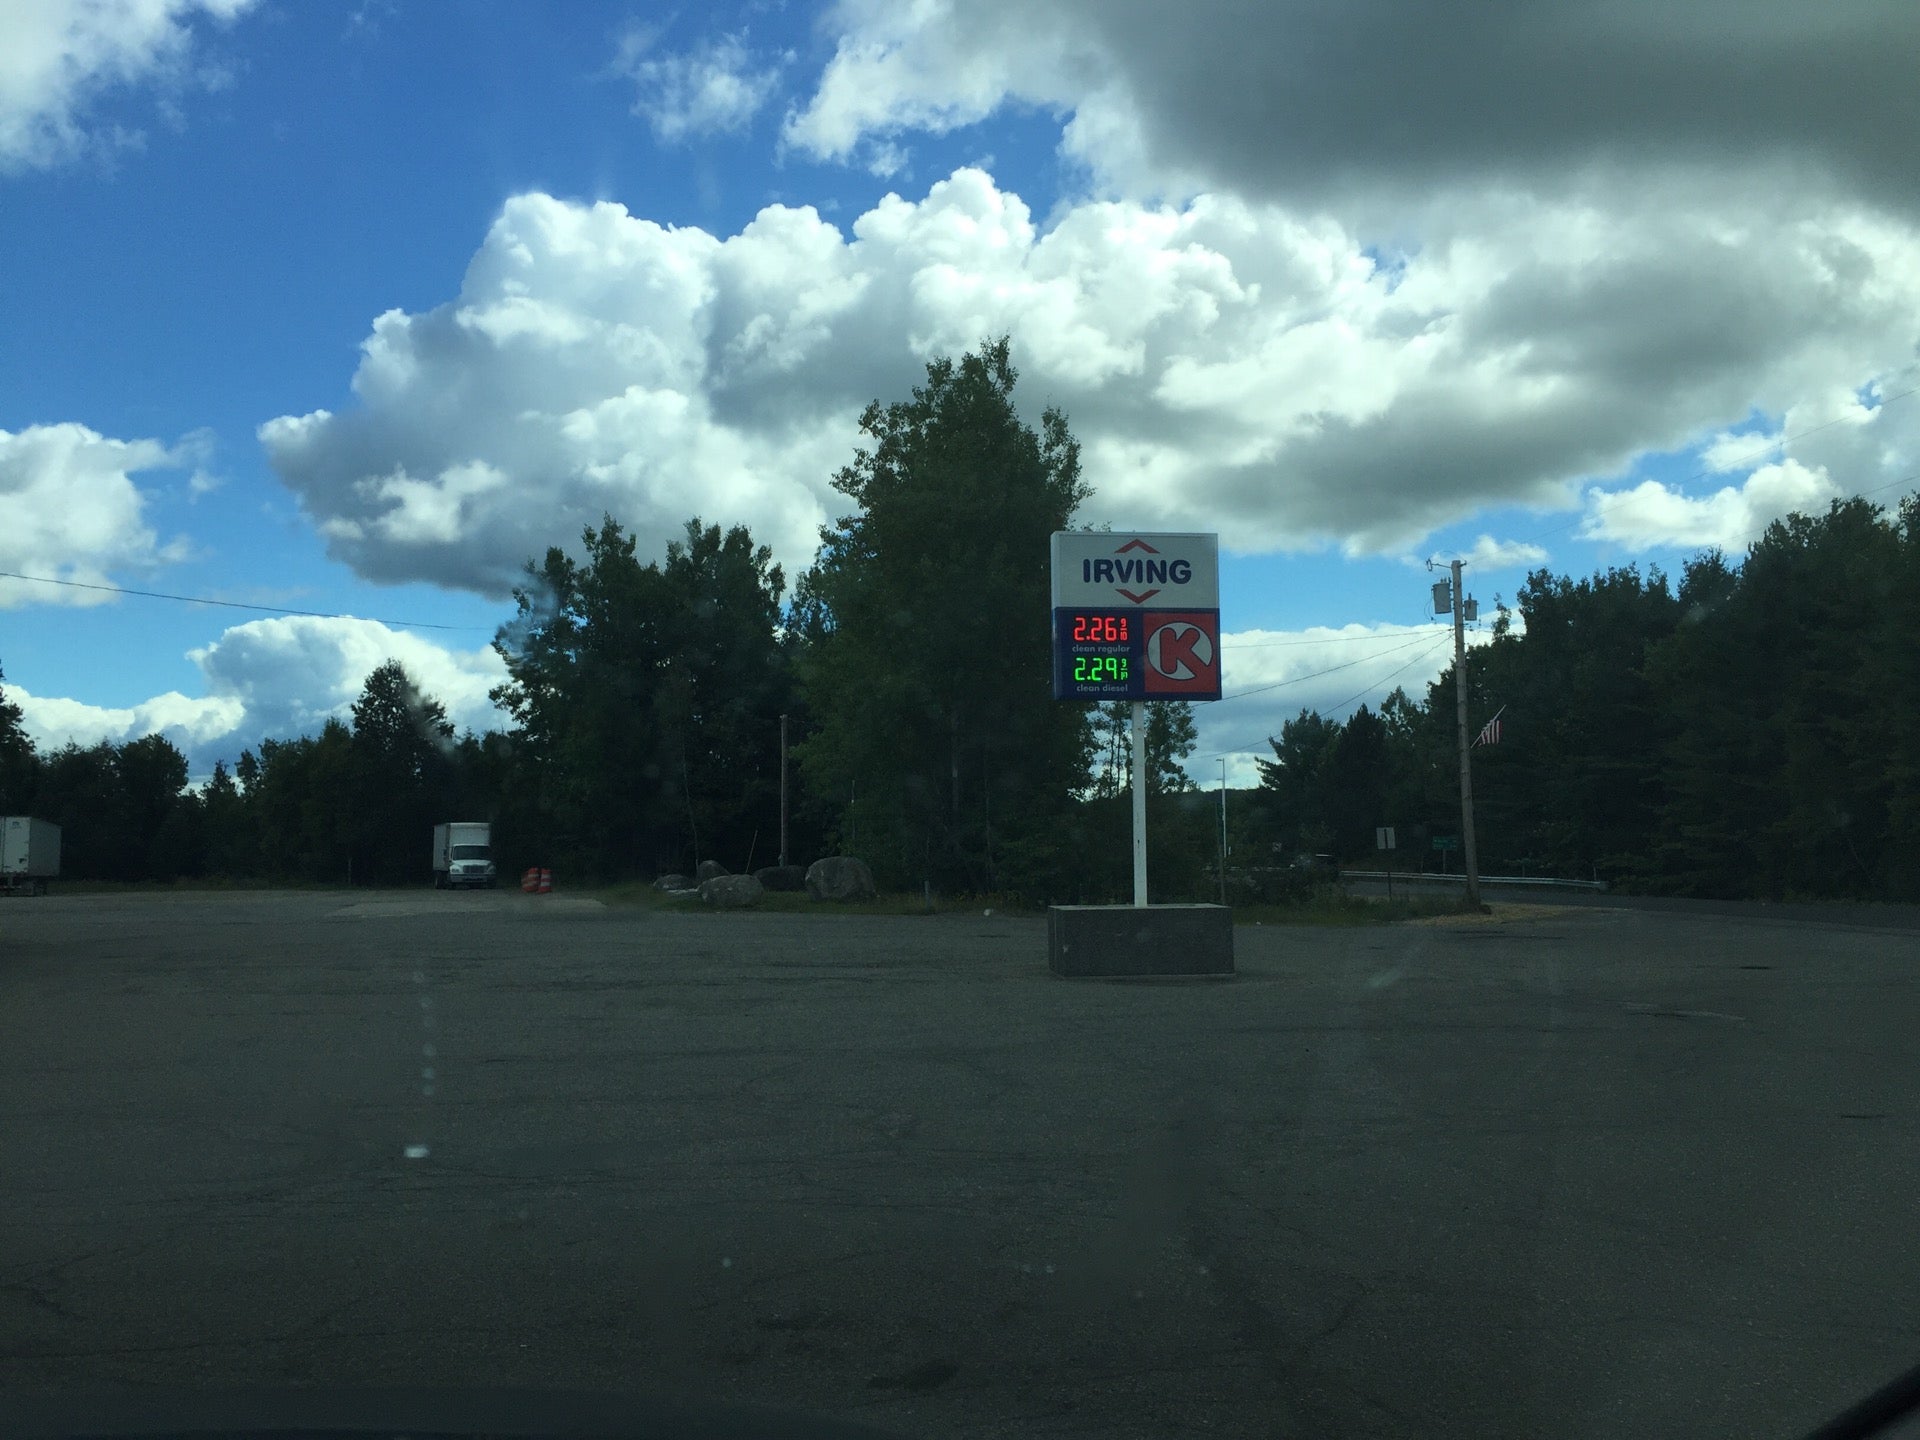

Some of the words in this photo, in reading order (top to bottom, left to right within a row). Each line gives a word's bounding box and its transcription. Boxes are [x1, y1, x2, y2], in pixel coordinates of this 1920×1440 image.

[1083, 559, 1192, 584] IRVING
[1074, 617, 1117, 641] 2.26
[1072, 644, 1096, 653] clean
[1098, 644, 1131, 654] regular
[1159, 627, 1209, 677] K
[1074, 657, 1117, 681] 2.29
[1076, 684, 1100, 692] clean
[1102, 684, 1128, 692] diesel
